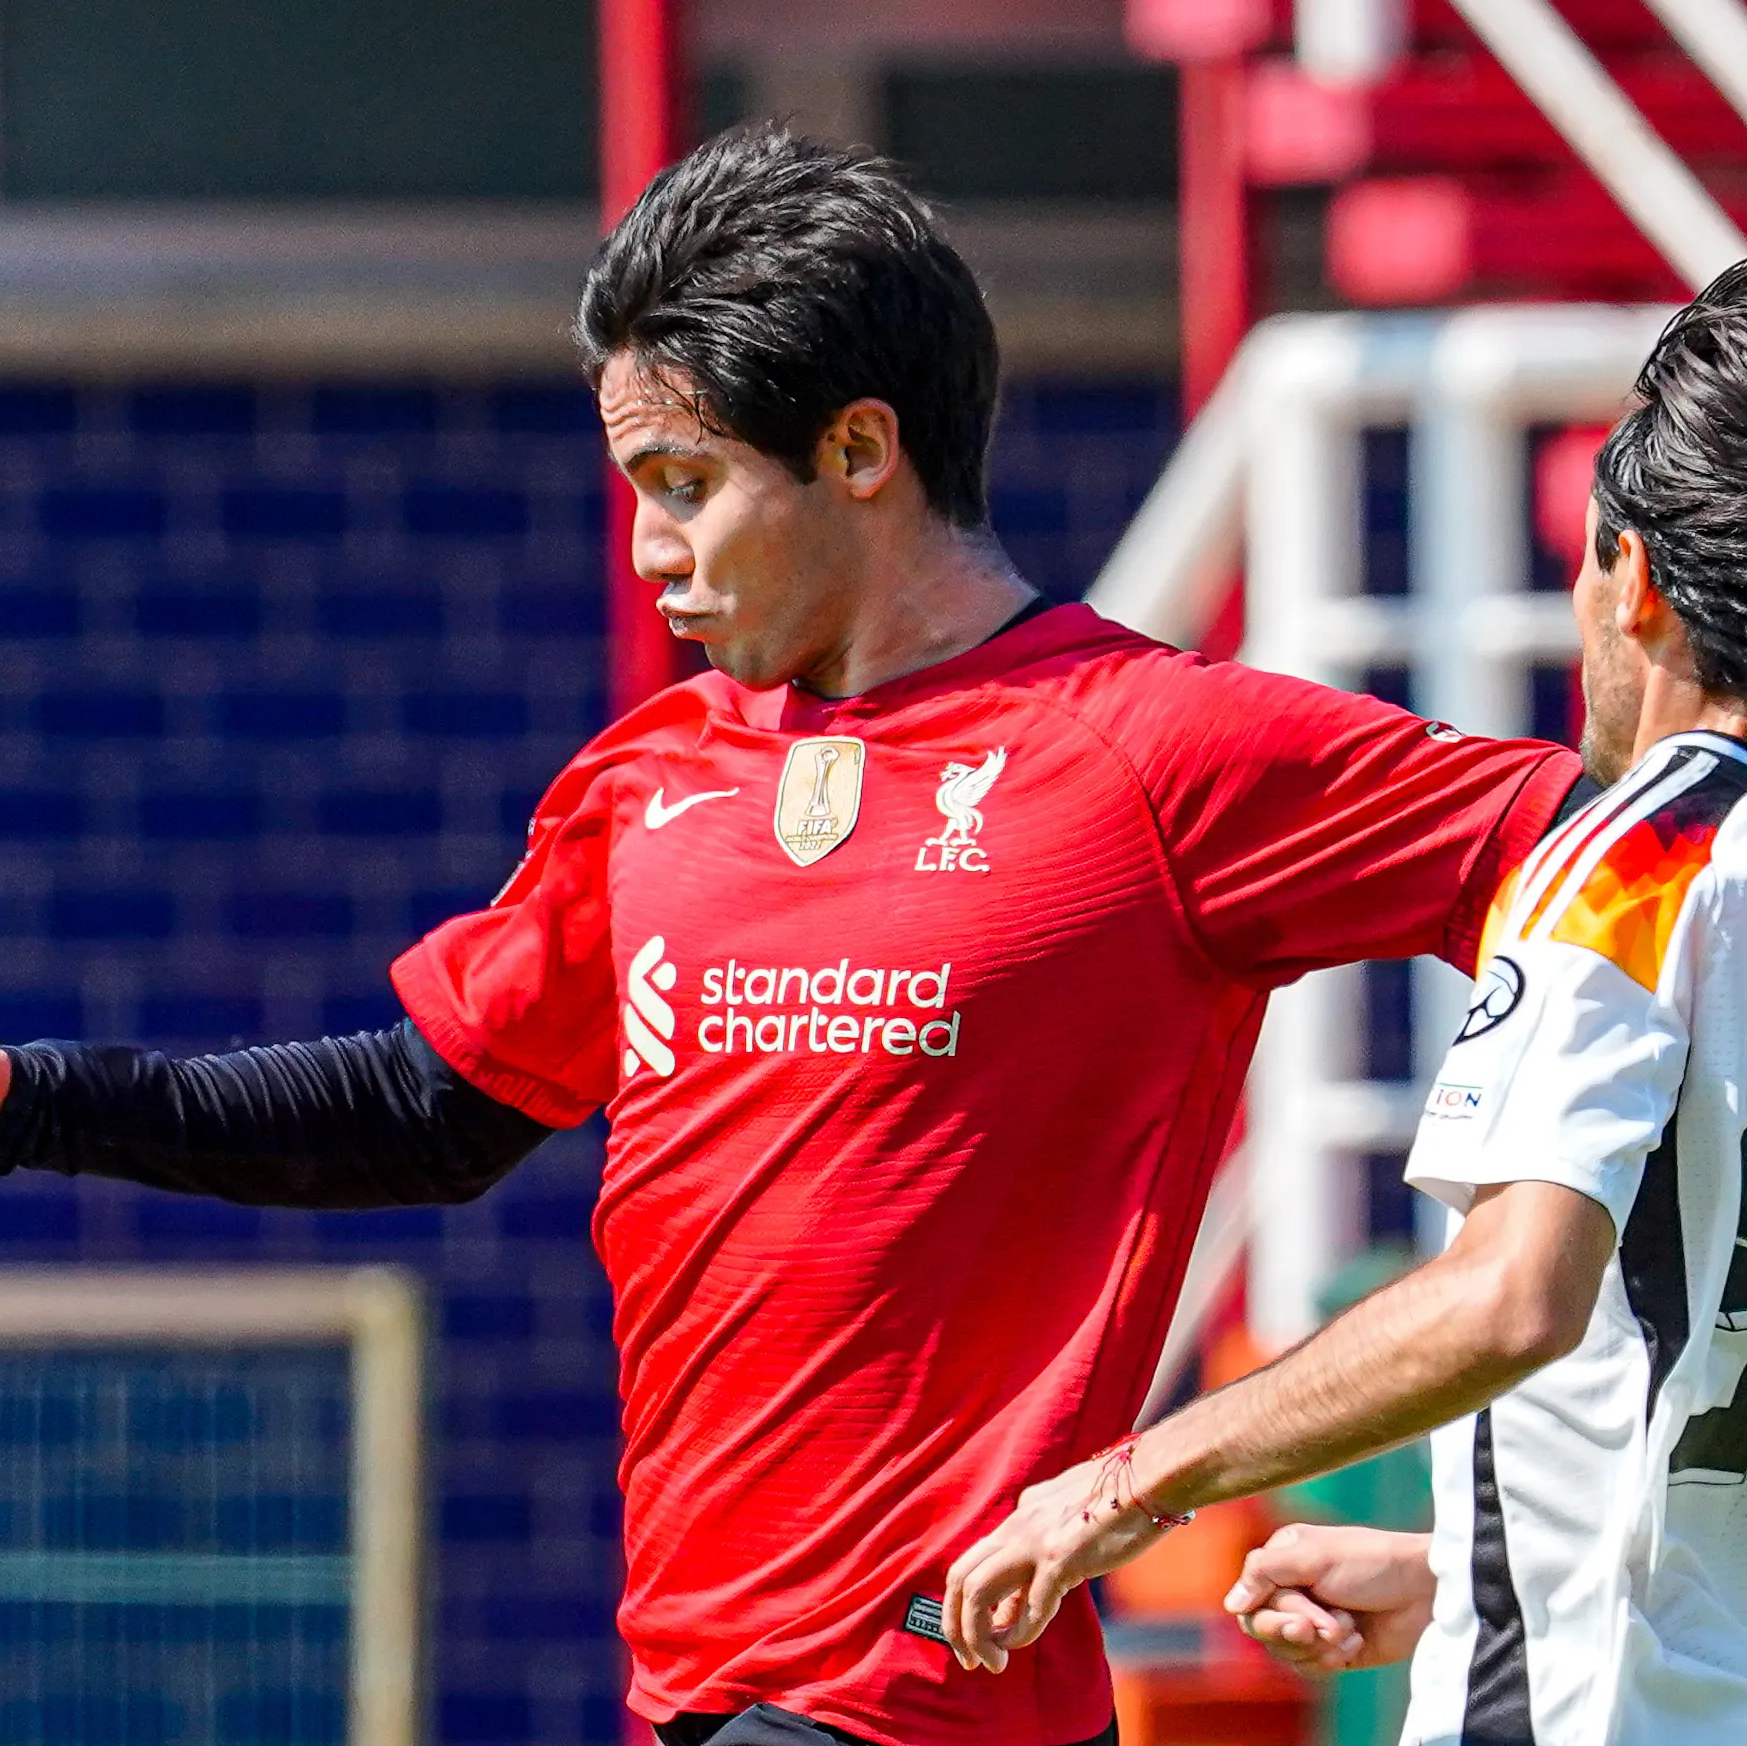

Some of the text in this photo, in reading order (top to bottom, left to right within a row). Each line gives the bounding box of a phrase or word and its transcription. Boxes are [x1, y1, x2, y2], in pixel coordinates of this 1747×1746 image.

[797, 819, 833, 836] FIFA
[700, 958, 952, 1009] standard
[697, 1006, 961, 1057] chartered
